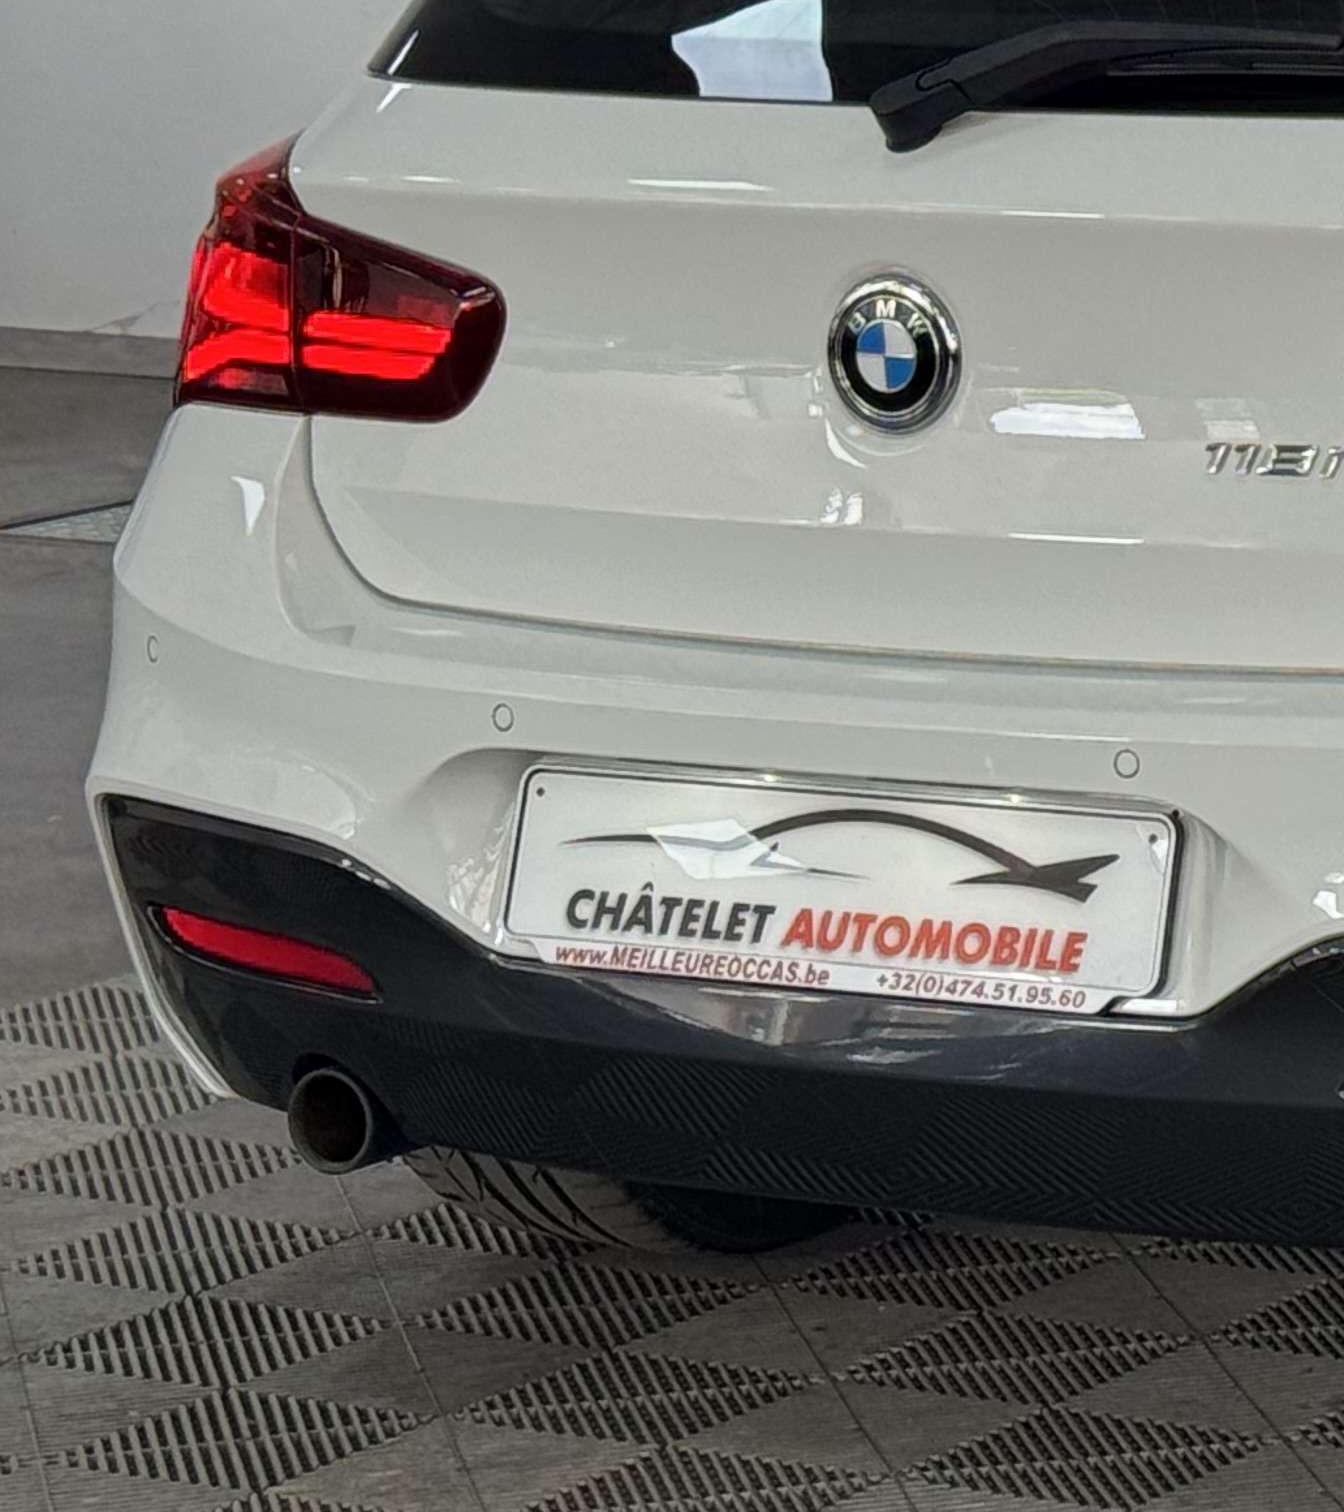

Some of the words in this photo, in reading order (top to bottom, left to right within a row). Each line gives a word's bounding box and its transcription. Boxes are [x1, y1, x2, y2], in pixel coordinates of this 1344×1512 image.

[565, 883, 776, 945] CHÂTELET
[781, 908, 1087, 972] AUTOMOBILE
[555, 946, 830, 985] www.MEILLEUREOCCAS.be
[876, 971, 1087, 1008] +32(0)474.51.95.60
